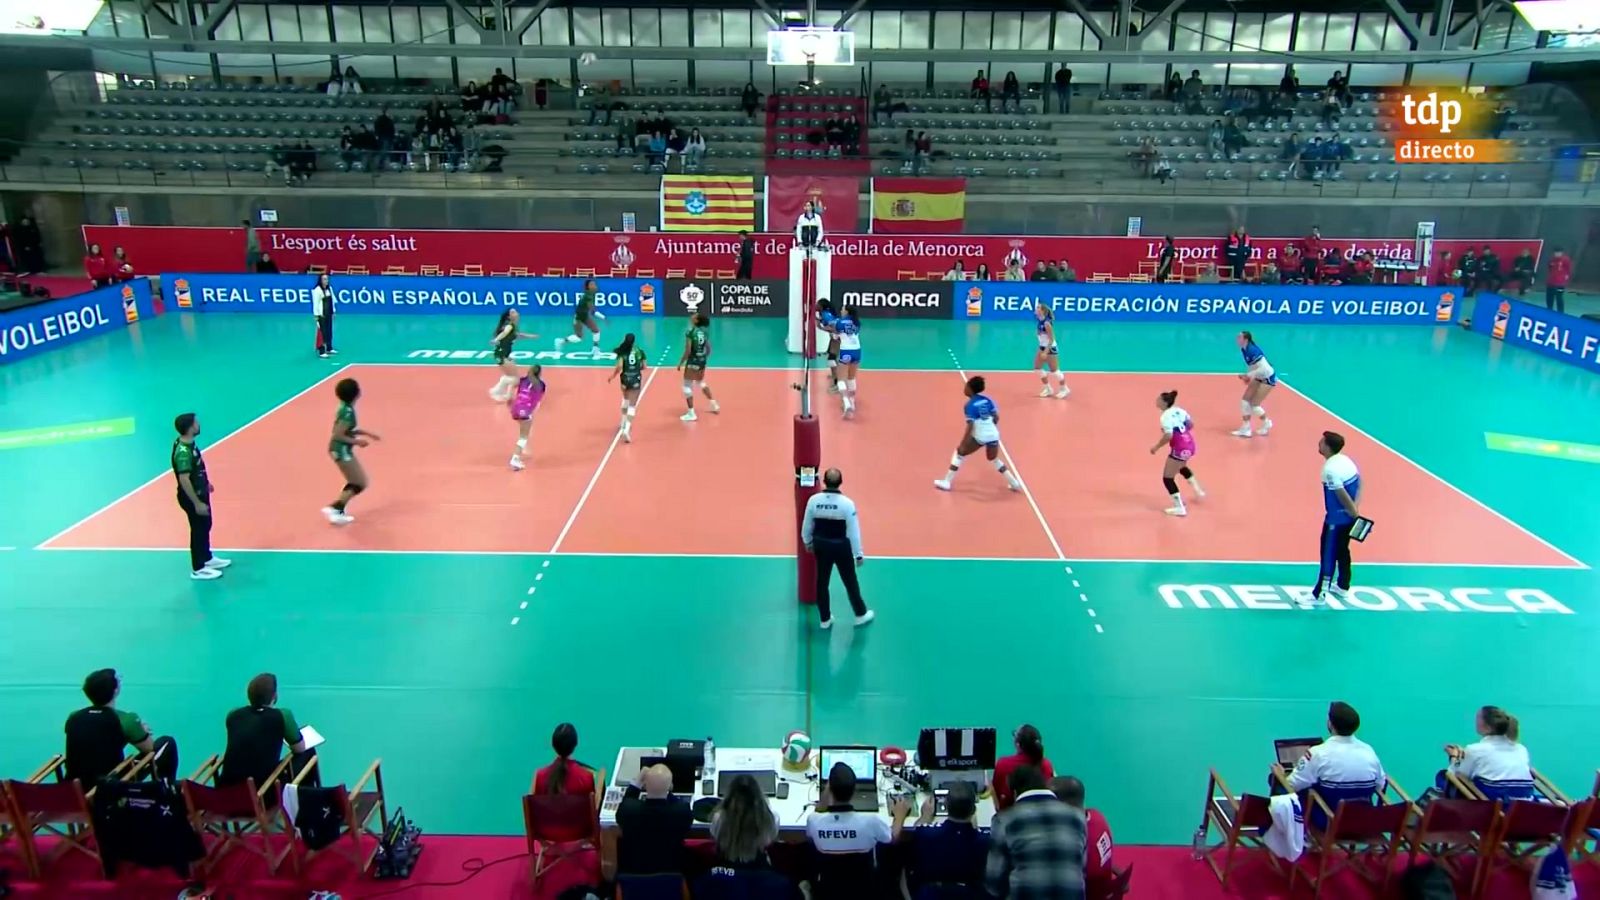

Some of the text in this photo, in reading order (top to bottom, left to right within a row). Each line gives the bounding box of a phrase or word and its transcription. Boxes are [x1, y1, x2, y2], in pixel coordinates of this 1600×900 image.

[271, 233, 418, 254] L'esport és salut
[654, 238, 760, 258] Ajuntamet
[765, 239, 786, 255] de
[882, 240, 904, 256] de
[907, 241, 984, 257] Menorca
[1267, 247, 1277, 260] a
[202, 287, 634, 307] REAL FEDECIÓN ESPAÑOLA DE VOLEBOL
[721, 285, 769, 295] COPA DE
[721, 296, 771, 305] LA REINA
[1052, 294, 1180, 313] FEDERACIÓN
[1186, 296, 1291, 314] ESPAÑOLA
[1297, 299, 1324, 314] DE
[1331, 300, 1430, 316] VOLEIBOL
[1517, 315, 1574, 355] REAL
[818, 829, 857, 839] RFEVB
